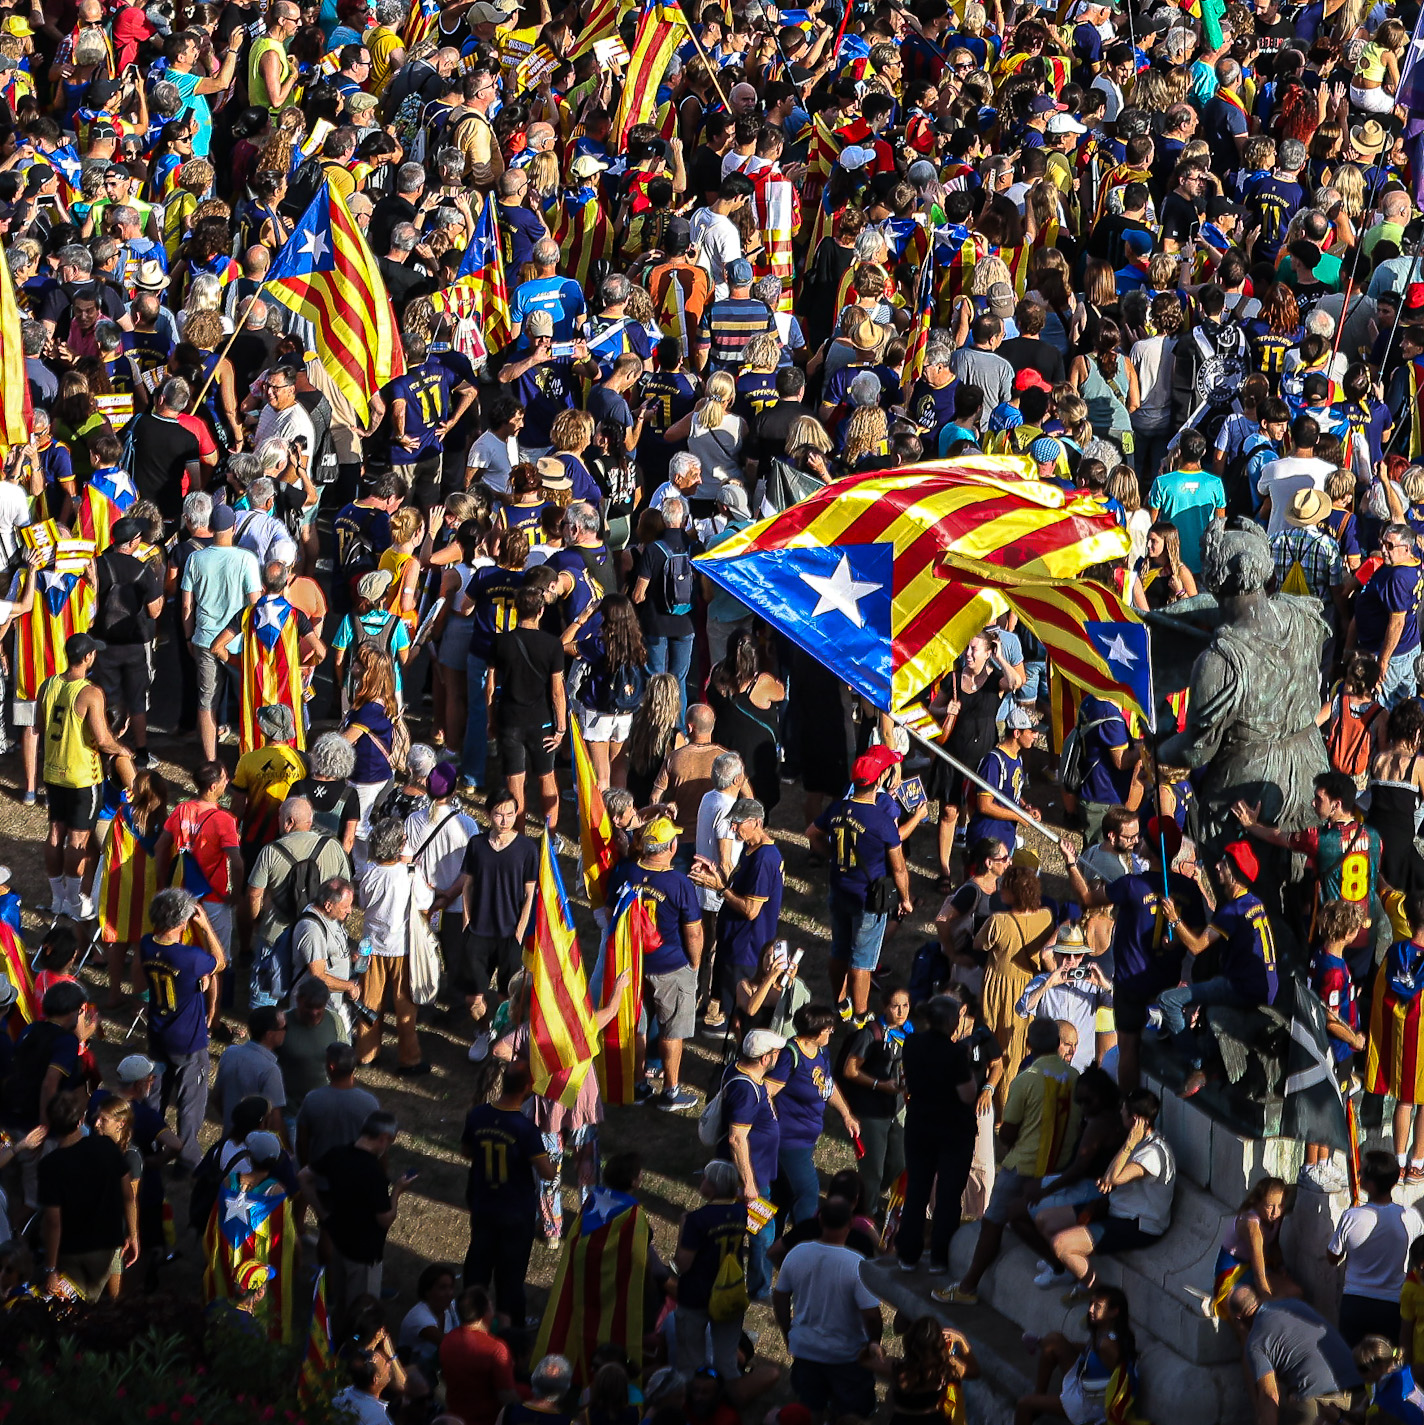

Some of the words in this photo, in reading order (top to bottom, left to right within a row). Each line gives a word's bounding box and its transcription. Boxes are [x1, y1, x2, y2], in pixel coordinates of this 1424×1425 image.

[416, 384, 442, 424] 11
[492, 597, 518, 634] 11
[50, 700, 66, 742] 5
[1340, 853, 1369, 903] 8
[149, 970, 177, 1012] 11
[481, 1140, 508, 1184] 11
